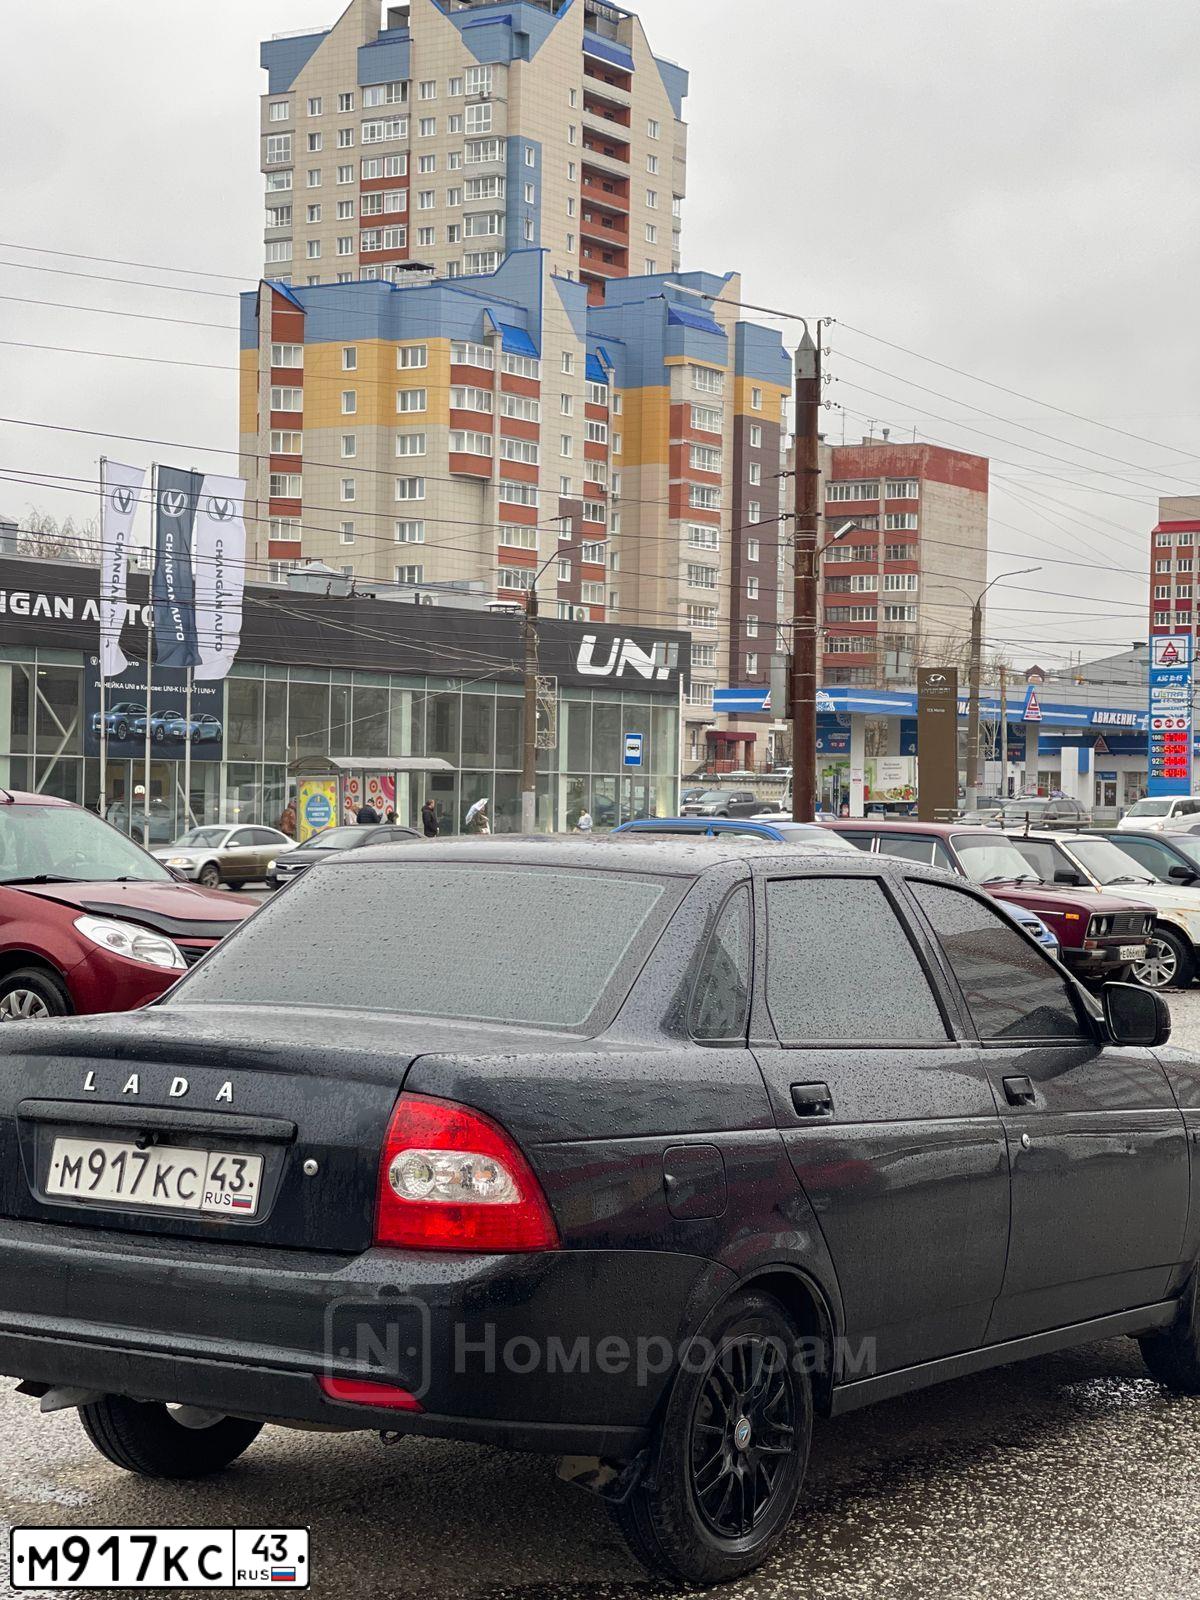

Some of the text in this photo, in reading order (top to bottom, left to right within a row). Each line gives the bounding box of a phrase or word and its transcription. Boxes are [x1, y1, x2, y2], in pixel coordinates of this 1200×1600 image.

[165, 533, 184, 641] CHANGAN AUTO
[214, 539, 224, 652] CHANGAN AUTO
[83, 1071, 234, 1103] LADA
[59, 1148, 248, 1200] М917КС 43
[204, 1191, 231, 1206] RUS
